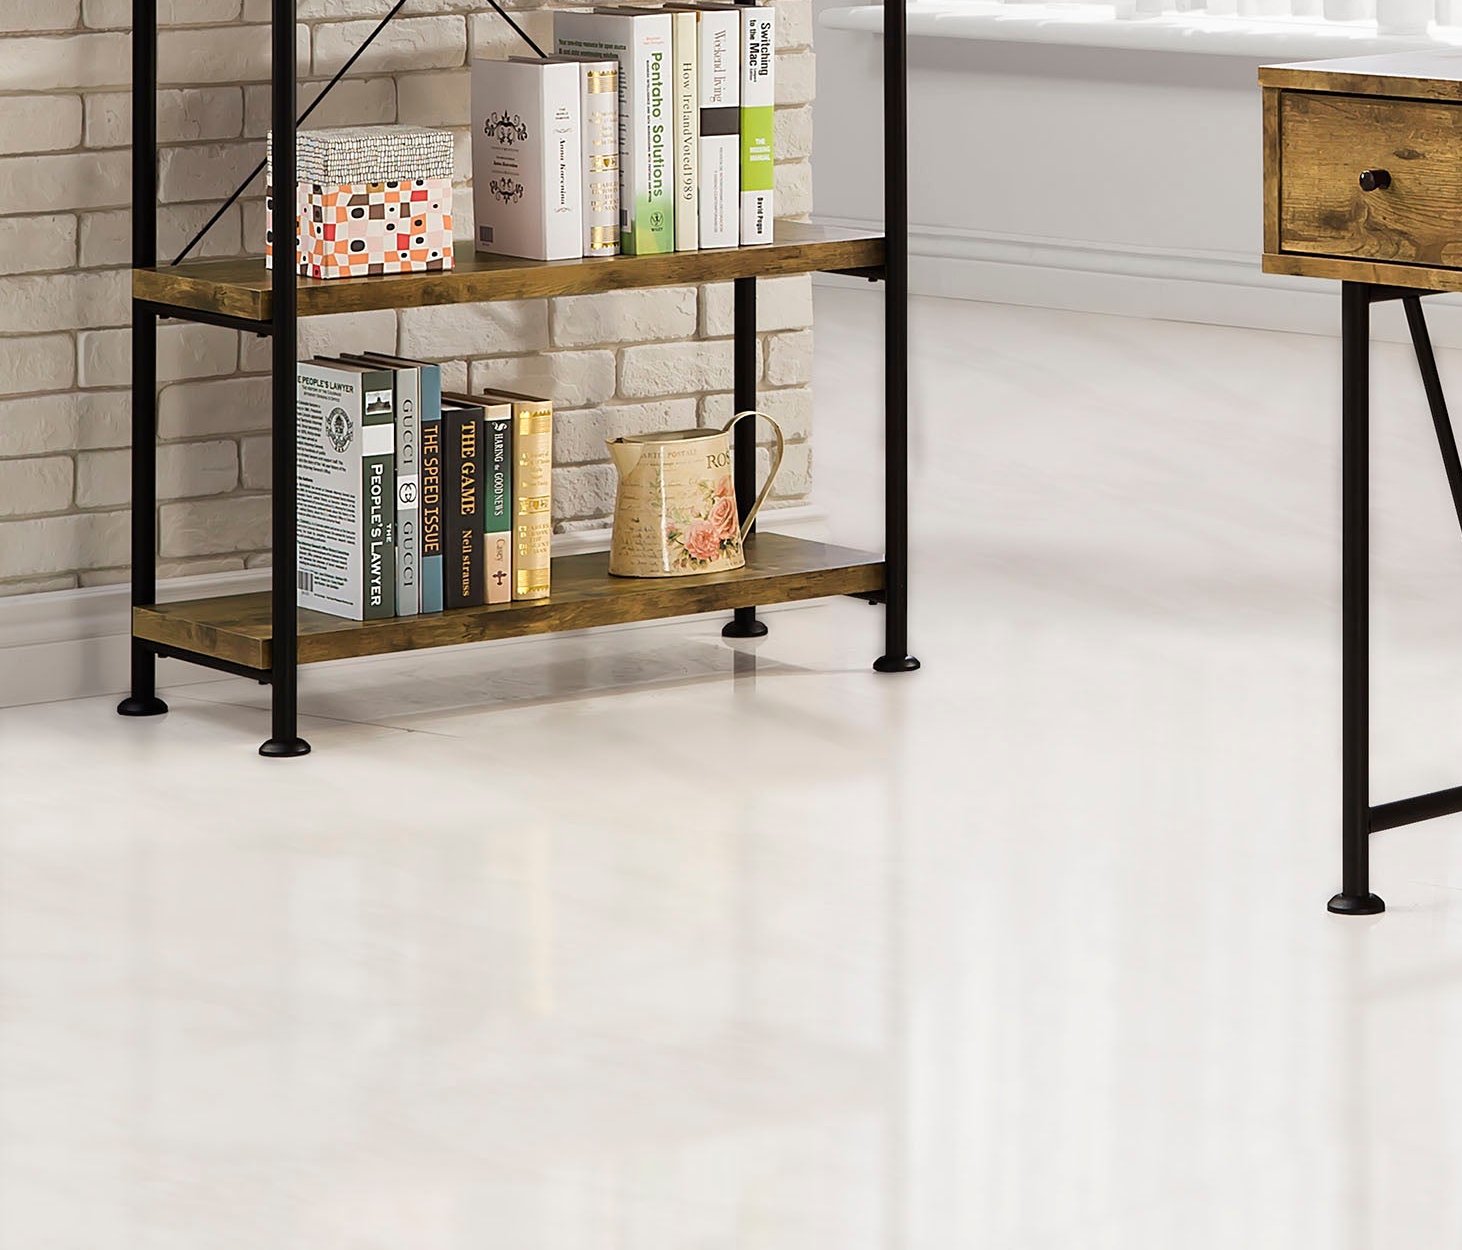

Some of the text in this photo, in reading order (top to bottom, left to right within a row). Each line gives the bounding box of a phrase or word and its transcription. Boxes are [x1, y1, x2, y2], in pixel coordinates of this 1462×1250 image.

[683, 63, 692, 89] How
[710, 30, 726, 103] Weekend living
[749, 19, 760, 67] to the Mac
[758, 22, 771, 76] Switching
[651, 52, 664, 118] Pentaho
[652, 124, 665, 197] Solutions
[302, 376, 329, 389] PEOPLE'S
[330, 381, 354, 393] LAWYER
[403, 399, 413, 464] GUCCI
[424, 425, 439, 553] THE SPEED ISSUE
[461, 421, 476, 516] THE GAME
[370, 463, 384, 607] PEOPLE'S LAWYER
[403, 521, 413, 587] GUCCI
[462, 530, 473, 597] Neil strauss
